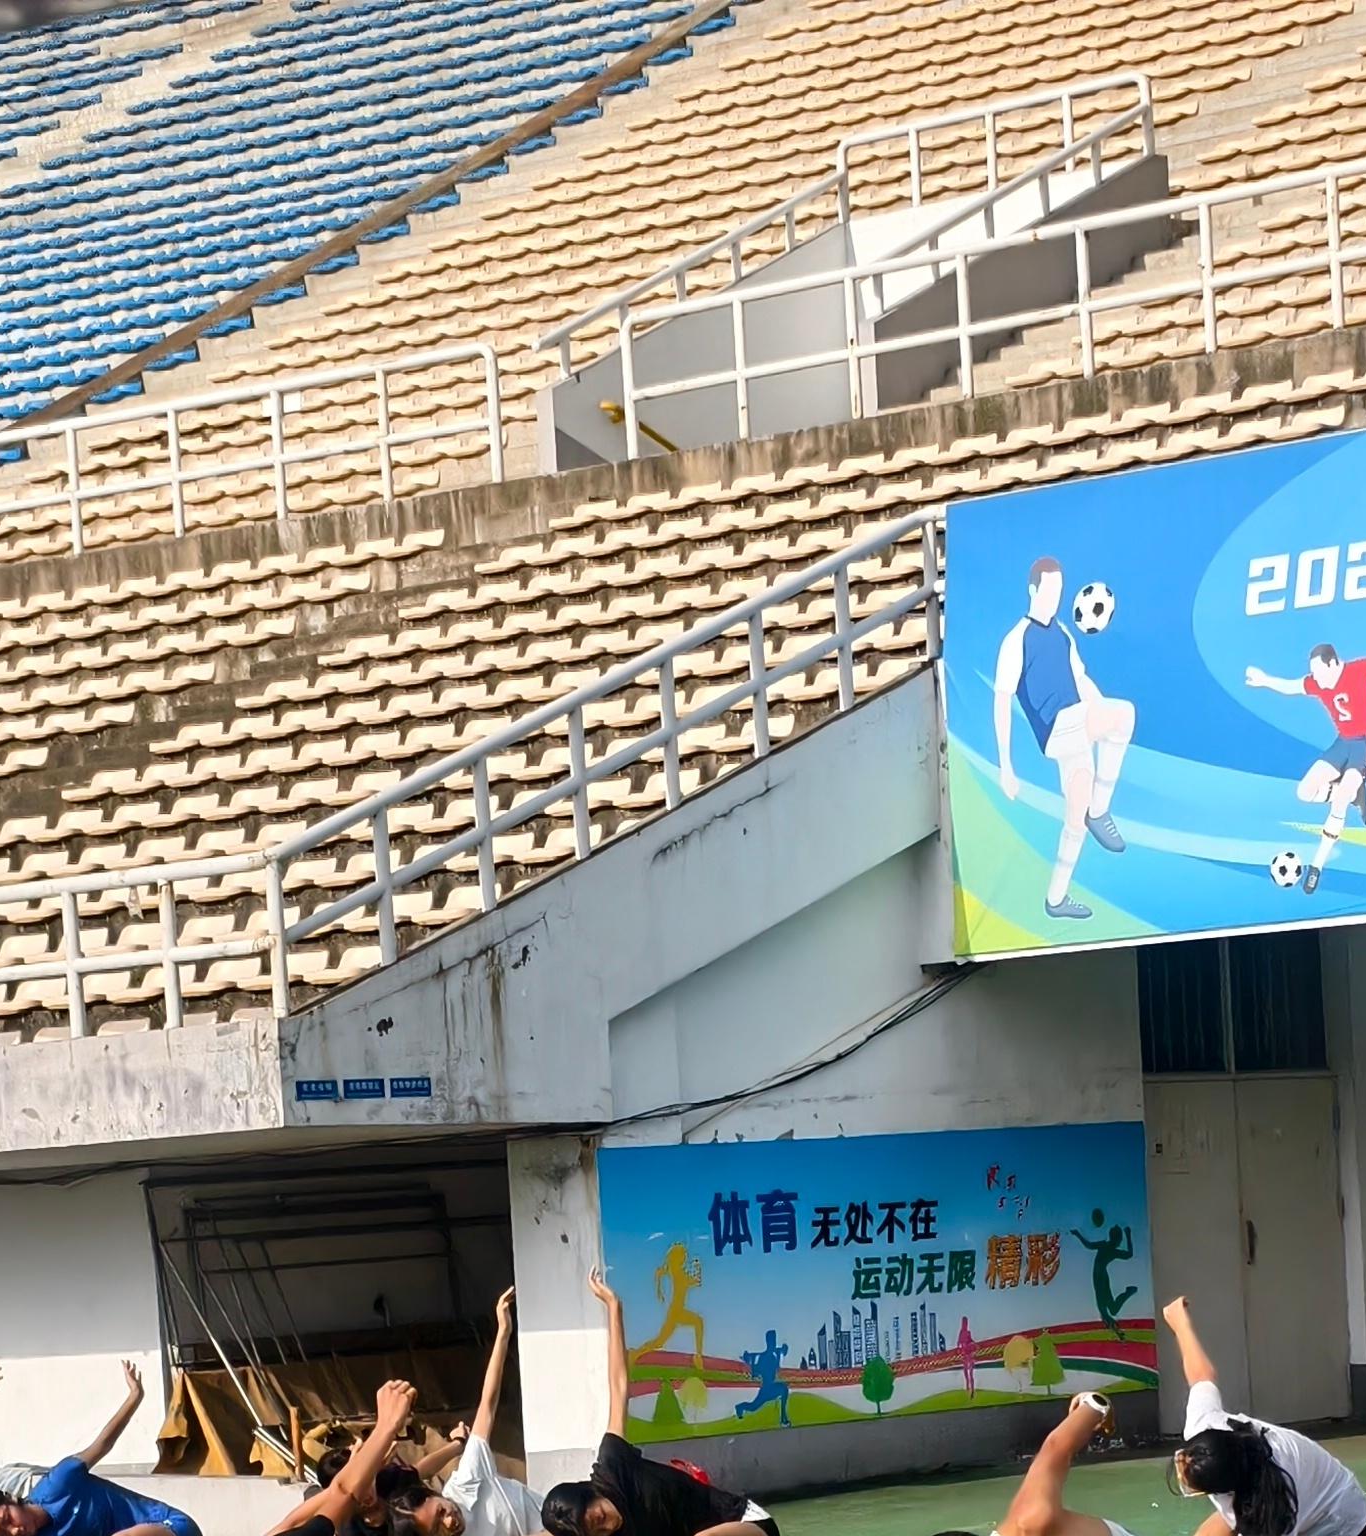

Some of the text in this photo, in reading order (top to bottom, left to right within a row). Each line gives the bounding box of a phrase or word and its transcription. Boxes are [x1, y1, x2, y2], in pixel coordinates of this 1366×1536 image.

[707, 1188, 939, 1257] 体育 无处不在
[851, 1250, 977, 1301] 运动无限
